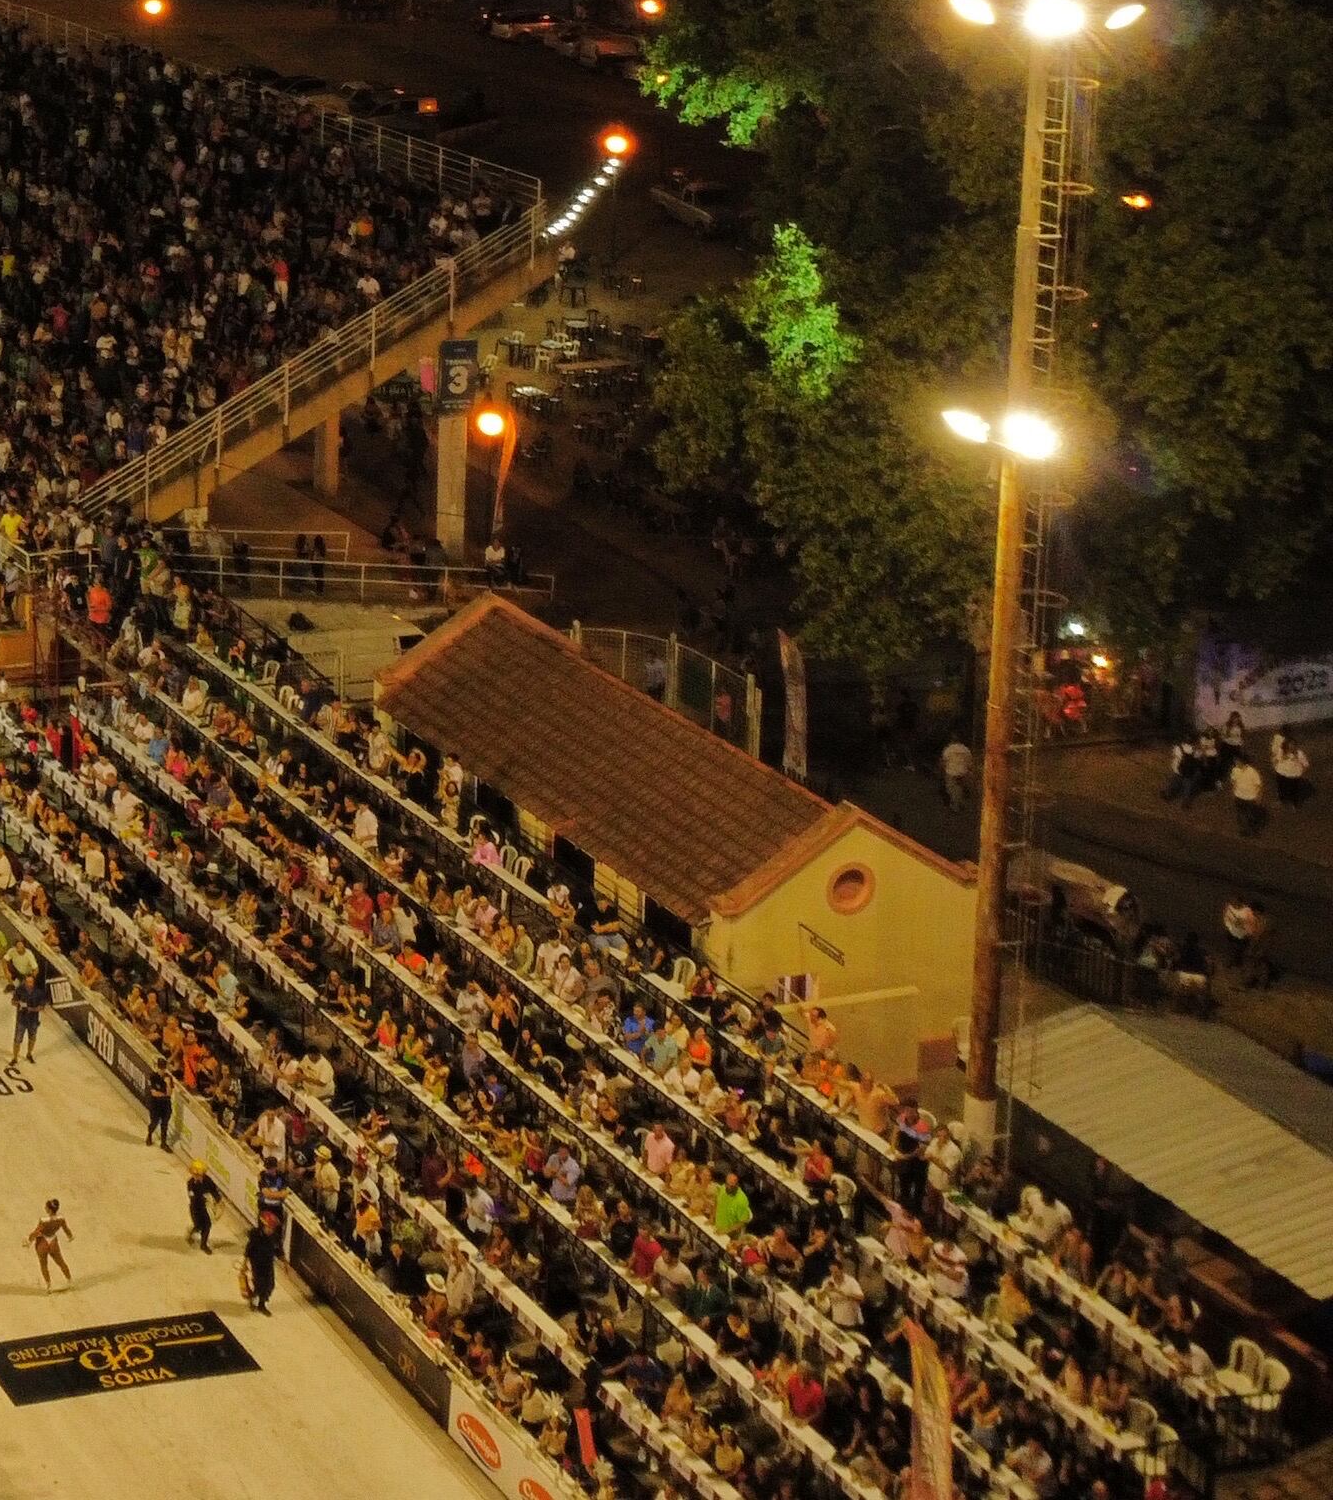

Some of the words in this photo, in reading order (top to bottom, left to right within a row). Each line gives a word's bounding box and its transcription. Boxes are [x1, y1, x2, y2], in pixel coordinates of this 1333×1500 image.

[447, 366, 469, 395] 3
[86, 1010, 115, 1067] SPEED
[6, 1335, 109, 1362] PALAVECINO
[98, 1365, 178, 1389] VINOS
